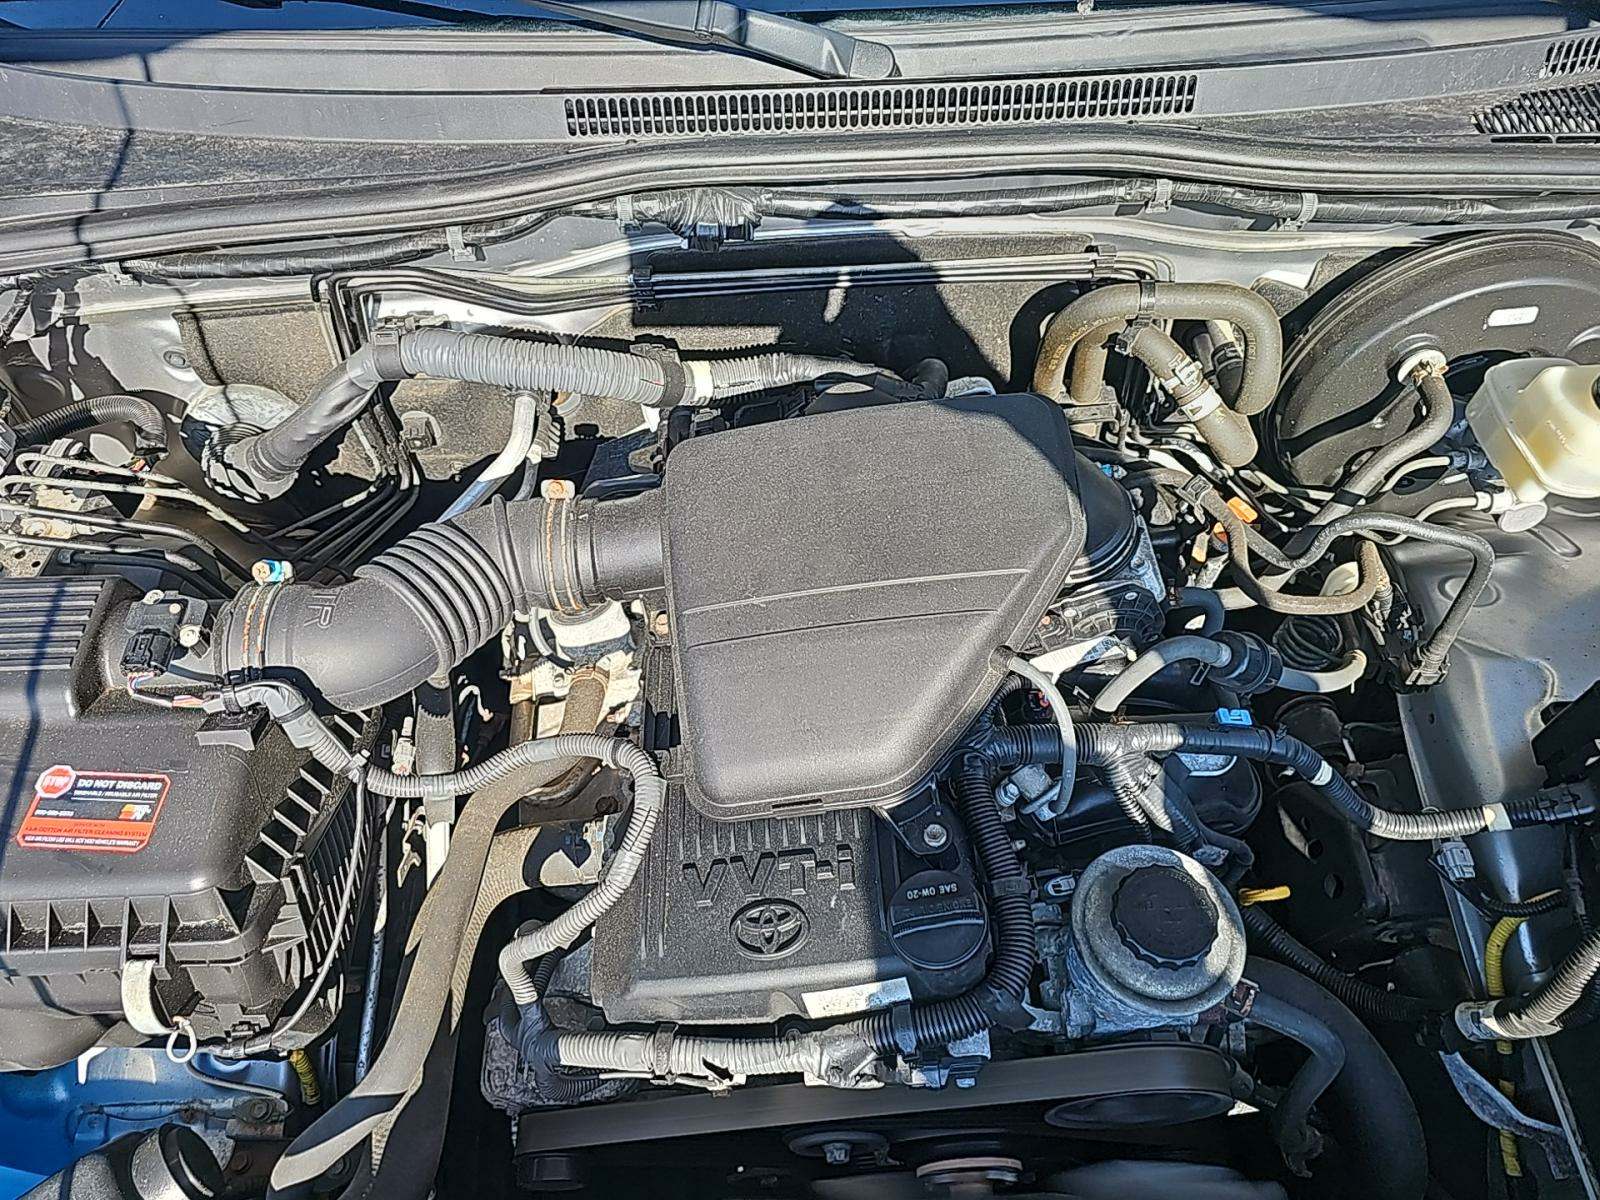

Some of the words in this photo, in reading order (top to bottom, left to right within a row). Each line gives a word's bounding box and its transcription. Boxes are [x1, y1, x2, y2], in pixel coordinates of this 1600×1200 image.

[77, 779, 94, 788] DO
[94, 779, 115, 789] NOT
[115, 780, 163, 791] DISCARD
[938, 883, 958, 895] SAE
